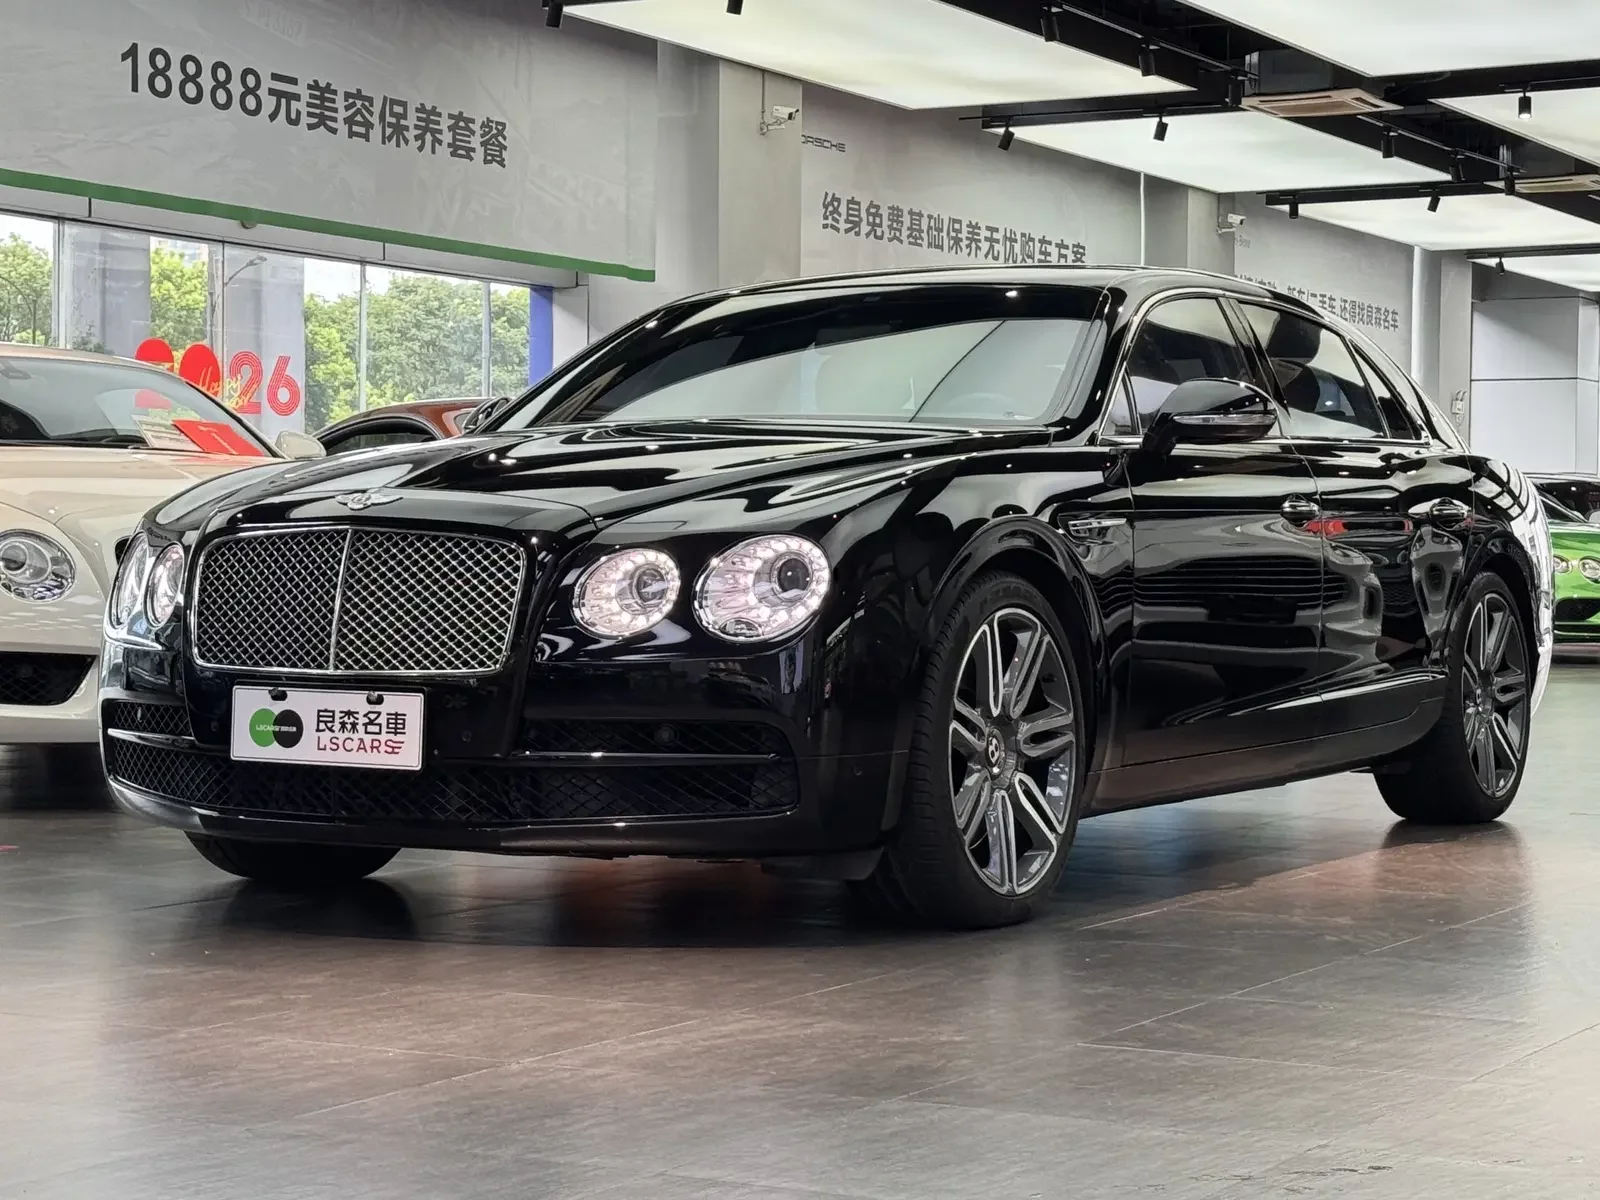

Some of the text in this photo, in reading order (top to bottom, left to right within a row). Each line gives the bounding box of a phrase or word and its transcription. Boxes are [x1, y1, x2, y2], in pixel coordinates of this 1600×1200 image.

[121, 42, 508, 168] 18888元美容保养套餐
[315, 708, 407, 736] 良森名車
[317, 736, 404, 755] LSCARS
